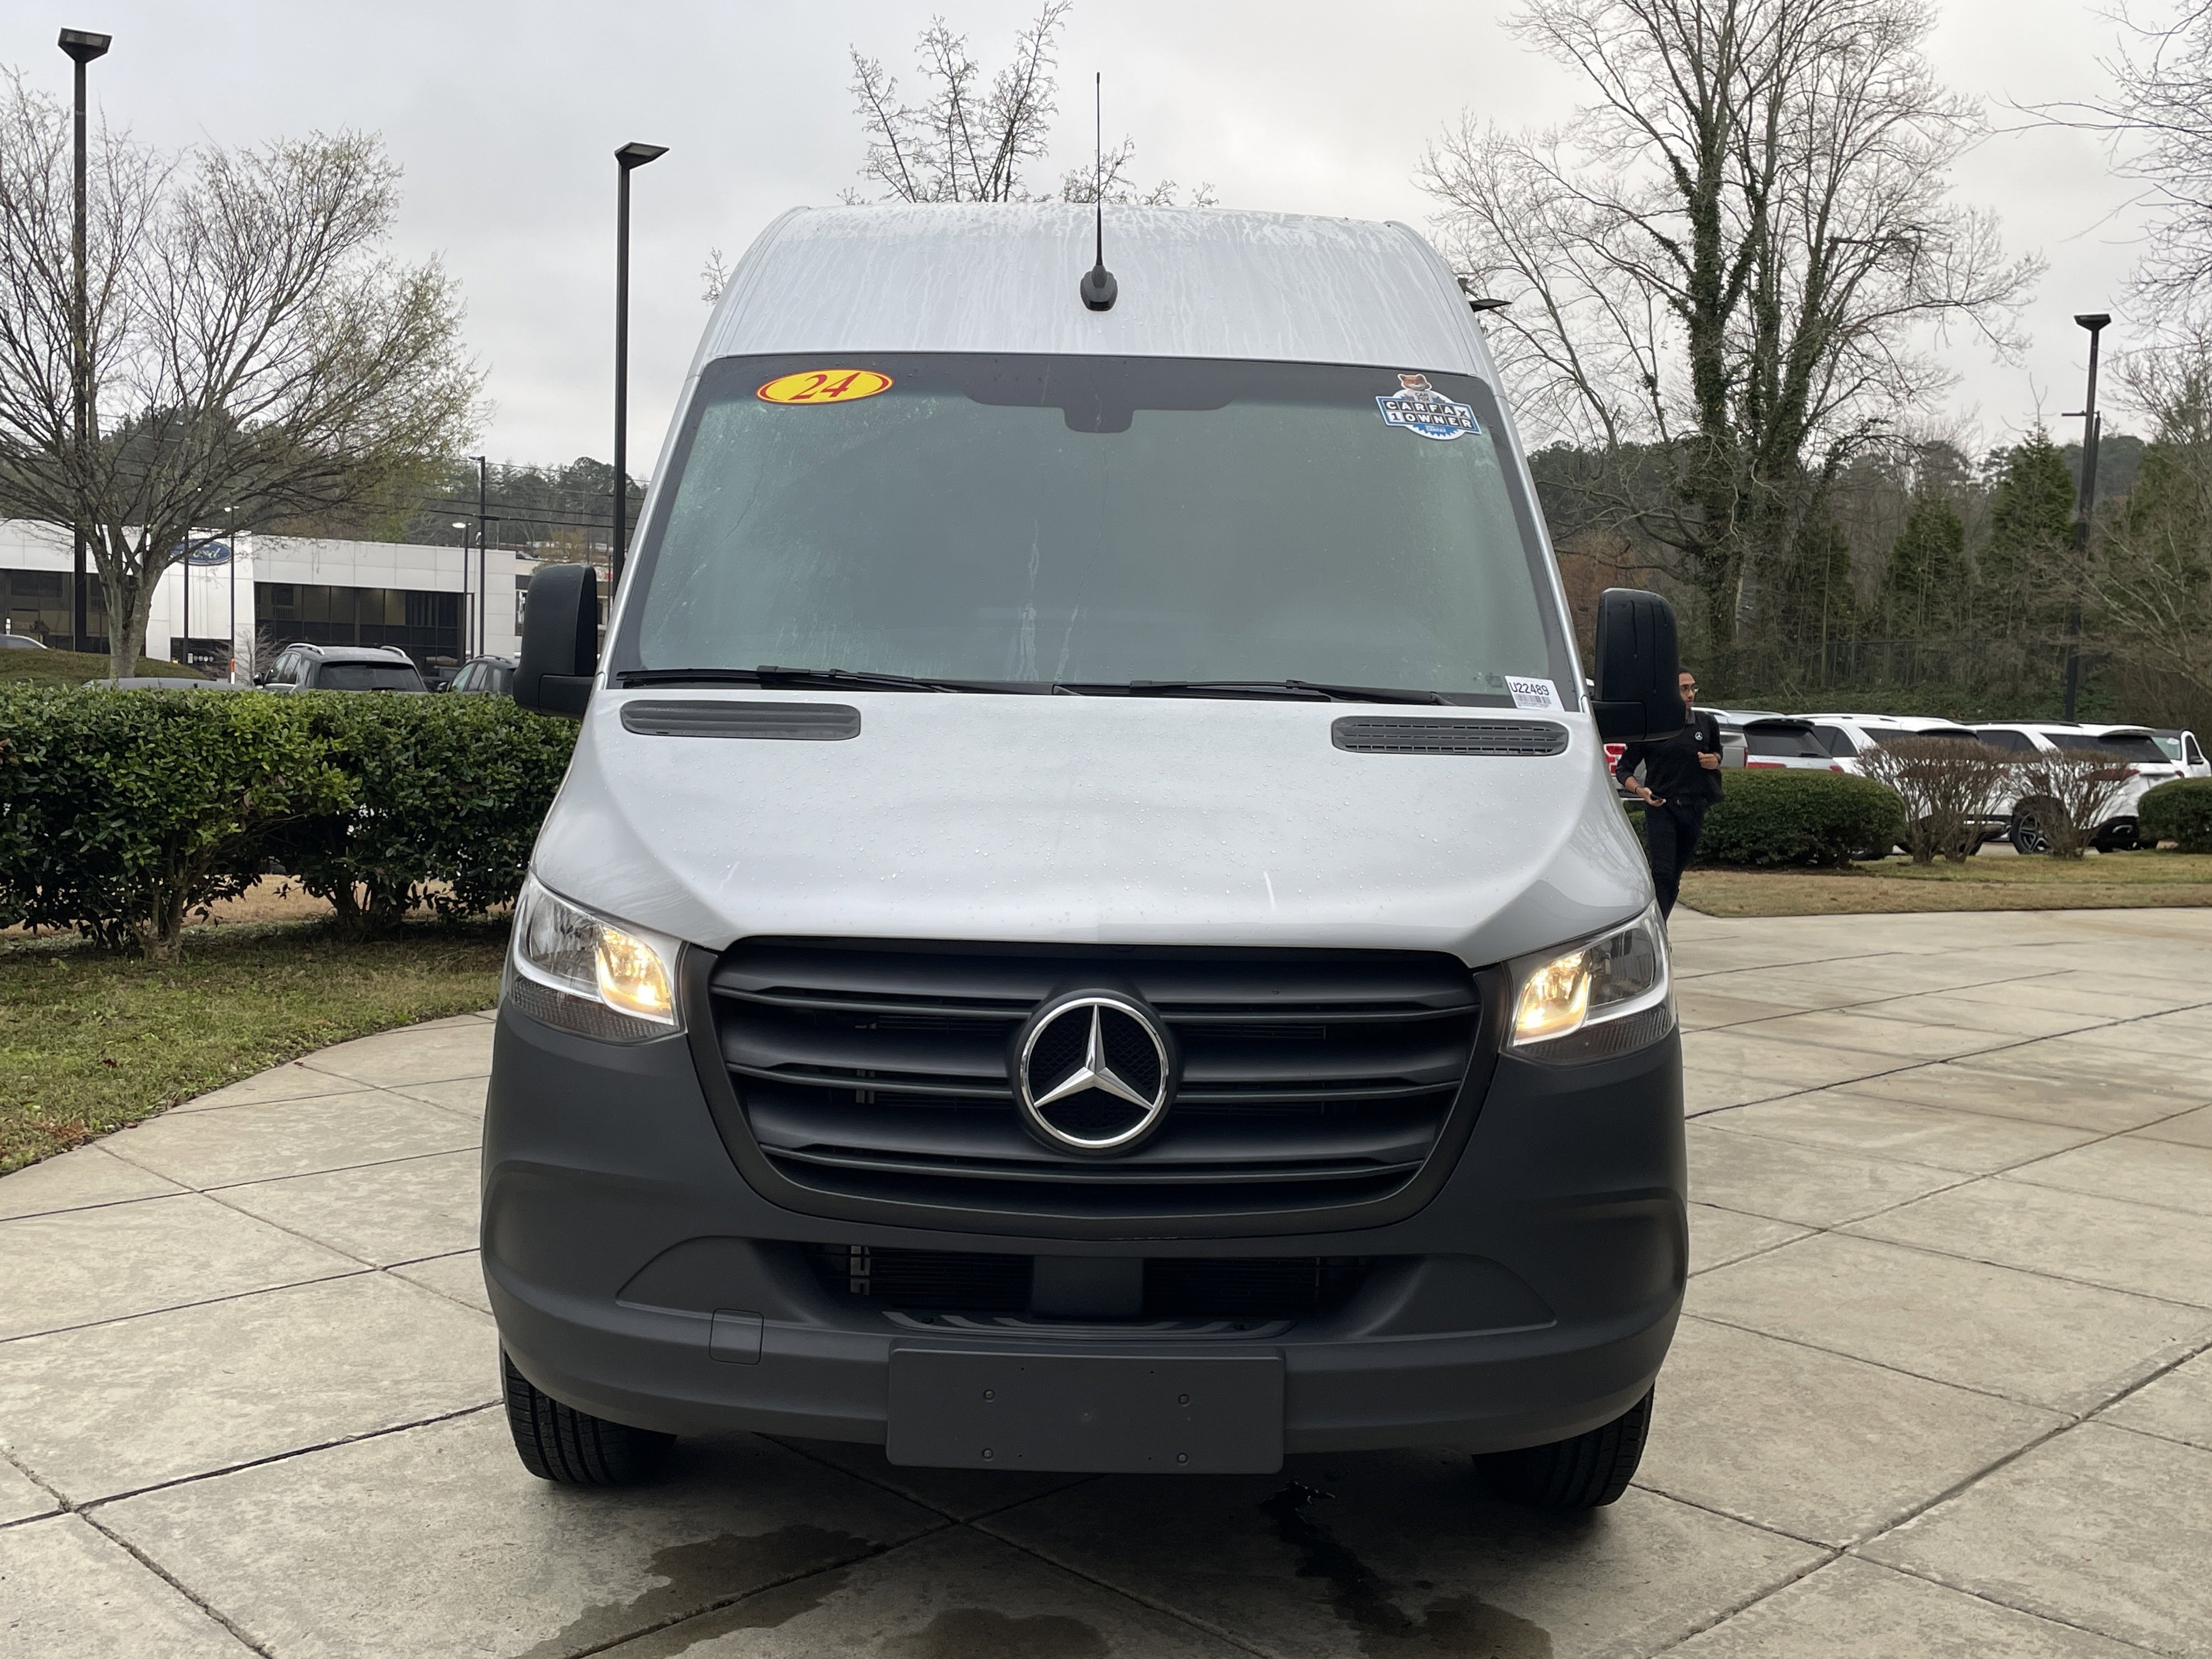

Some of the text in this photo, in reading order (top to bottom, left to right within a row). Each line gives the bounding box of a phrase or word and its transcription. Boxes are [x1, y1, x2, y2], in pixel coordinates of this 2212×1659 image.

[788, 372, 862, 400] 24
[1385, 401, 1470, 417] CARFAX
[1509, 682, 1550, 696] U22489
